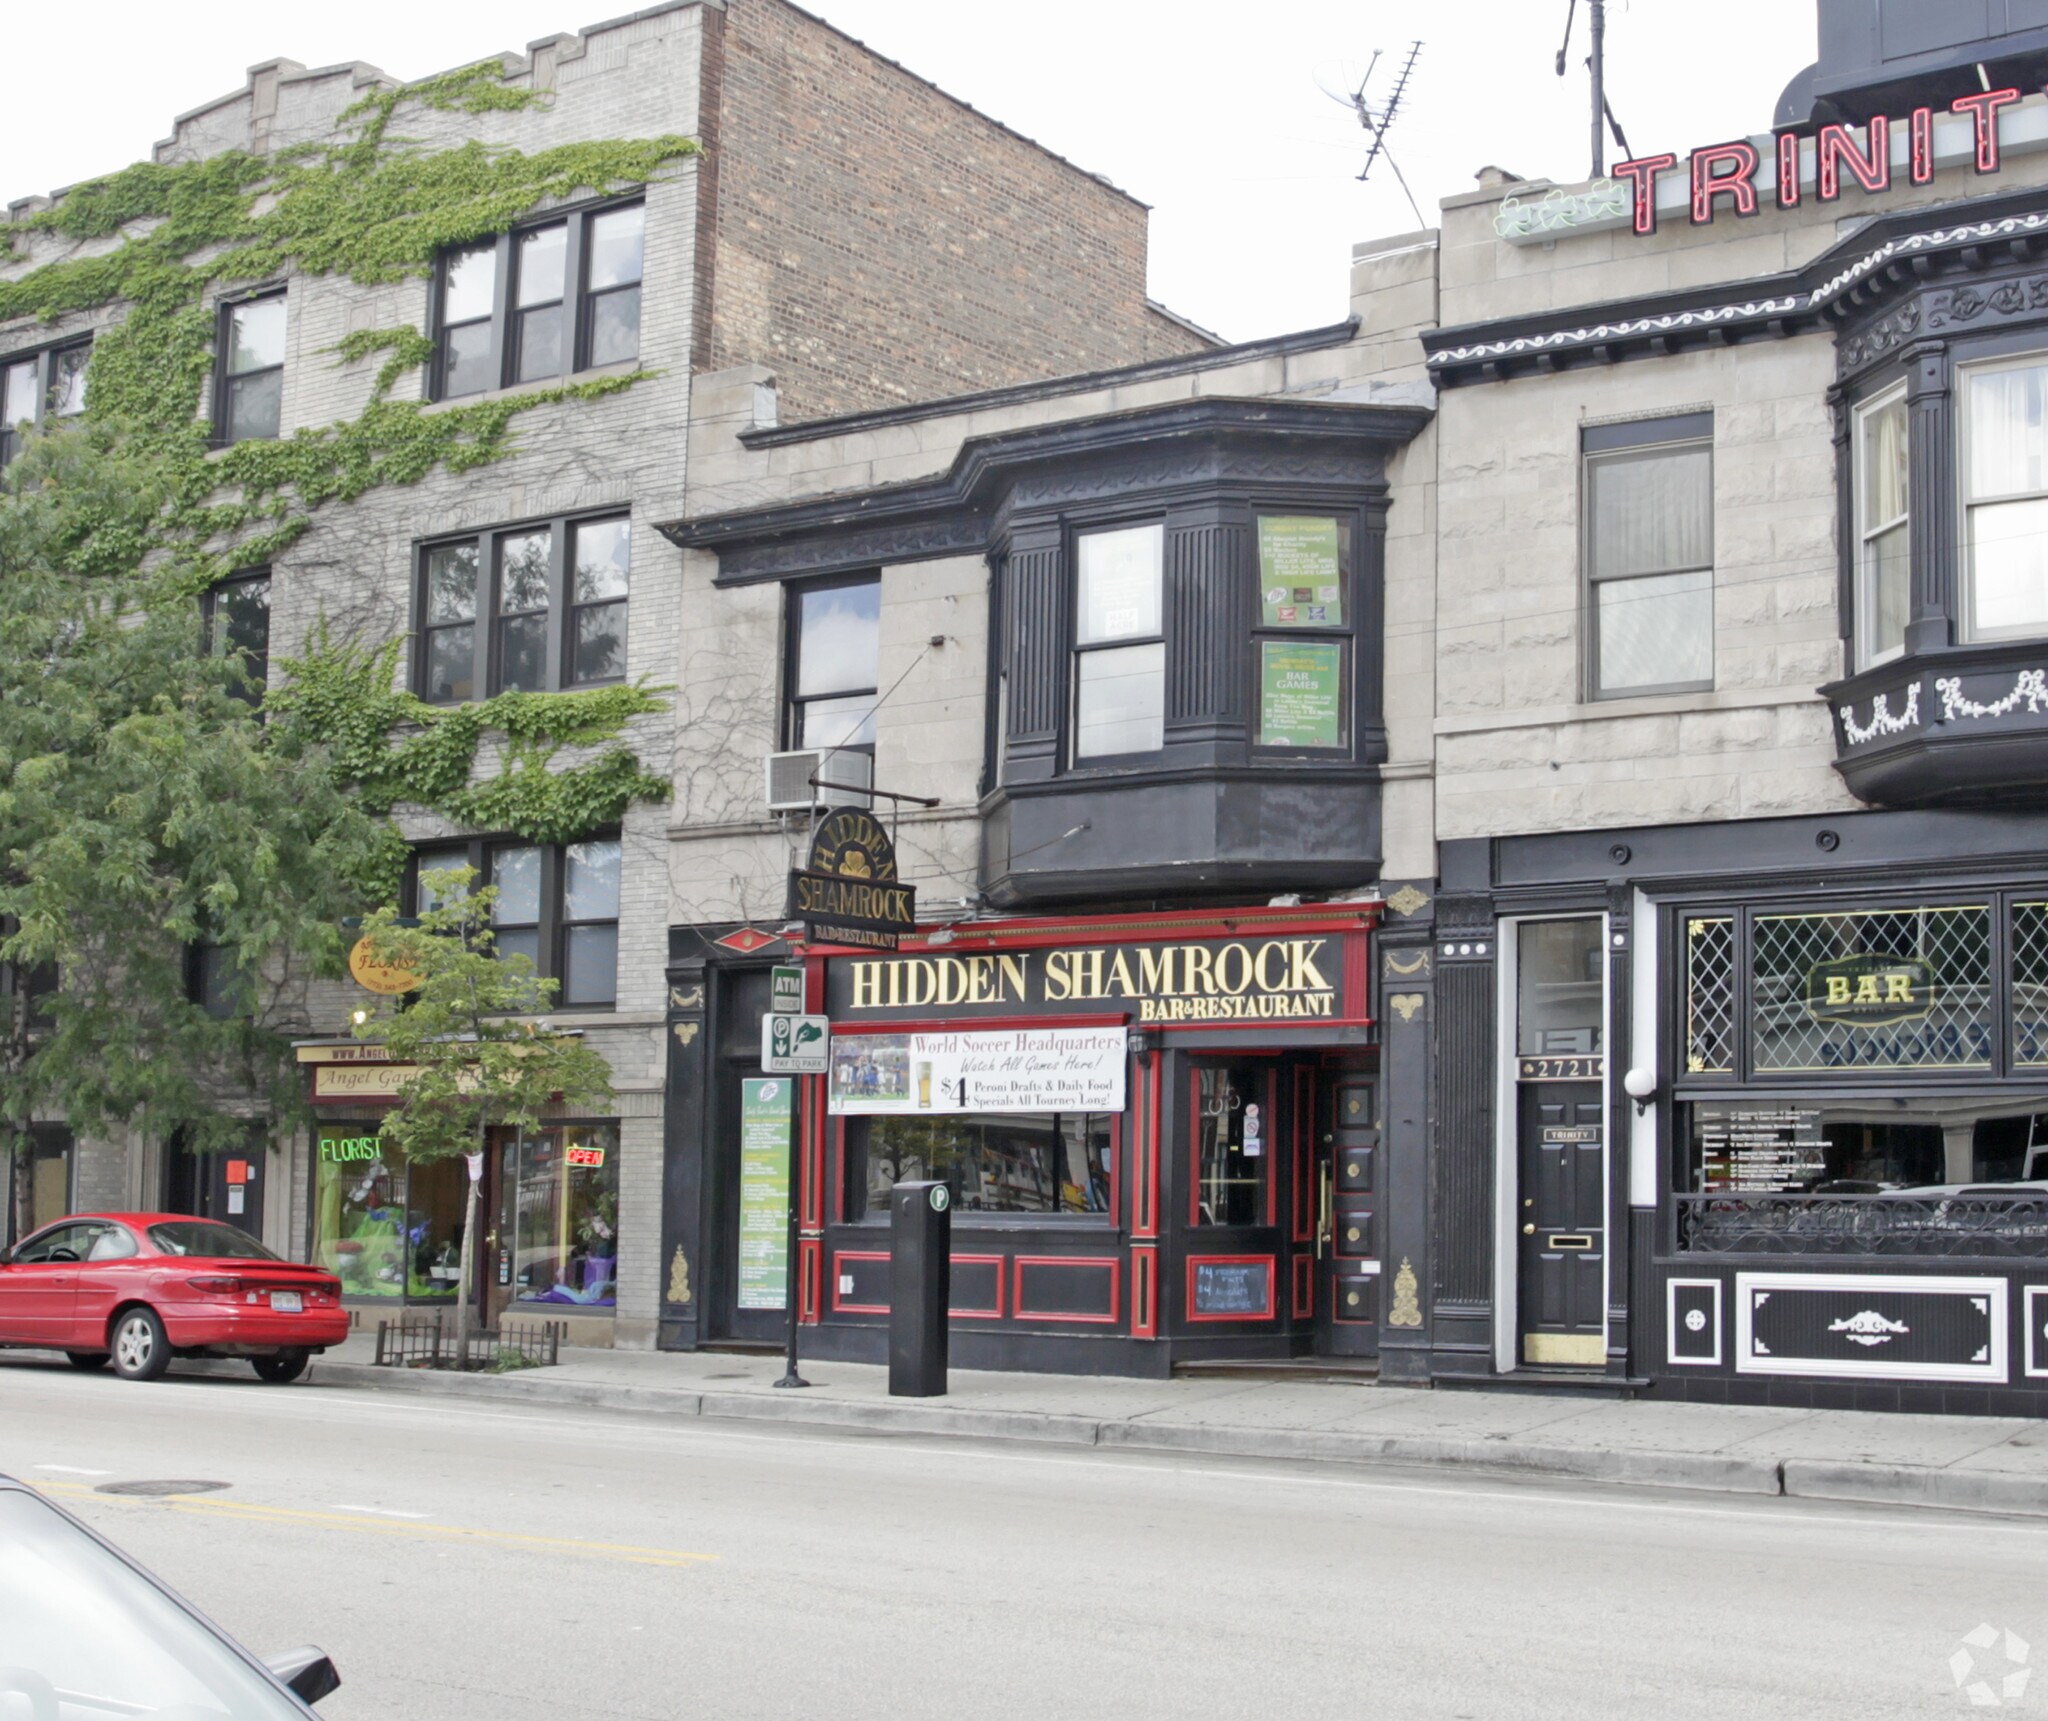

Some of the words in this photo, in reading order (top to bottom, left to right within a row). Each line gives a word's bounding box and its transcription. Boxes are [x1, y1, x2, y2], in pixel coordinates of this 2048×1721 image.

[1611, 86, 2048, 235] TRINIT
[1276, 680, 1319, 690] GAMES
[1286, 671, 1309, 680] BAR
[815, 813, 895, 881] HIDDEN
[797, 877, 912, 923] SHAMROCK
[775, 976, 800, 993] ATM
[850, 954, 1030, 1008] HIDDEN
[1045, 940, 1334, 1003] SHAMROCK
[1825, 975, 1915, 1006] BAR
[915, 1035, 957, 1053] World
[962, 1033, 1011, 1053] Soccer
[1015, 1032, 1121, 1056] Headquarters
[774, 1059, 788, 1067] PAY
[791, 1059, 801, 1068] TO
[961, 1057, 996, 1073] Watch
[1000, 1055, 1024, 1072] All
[1025, 1055, 1060, 1075] Games
[1064, 1054, 1103, 1072] Here!
[1538, 1060, 1594, 1077] 2721
[320, 1068, 375, 1089] Angel
[974, 1080, 1007, 1092] Peroni
[1010, 1080, 1042, 1092] Drafts
[1045, 1079, 1053, 1091] &
[1058, 1079, 1083, 1092] Daily
[1088, 1079, 1113, 1091] Food
[941, 1077, 970, 1108] $4
[973, 1095, 1014, 1109] Specials
[1018, 1094, 1031, 1106] All
[1035, 1093, 1076, 1107] Tourney
[1080, 1092, 1111, 1107] Long!
[1551, 1131, 1589, 1139] TRINITY
[320, 1137, 383, 1162] FLORIST
[568, 1149, 603, 1164] OPEN
